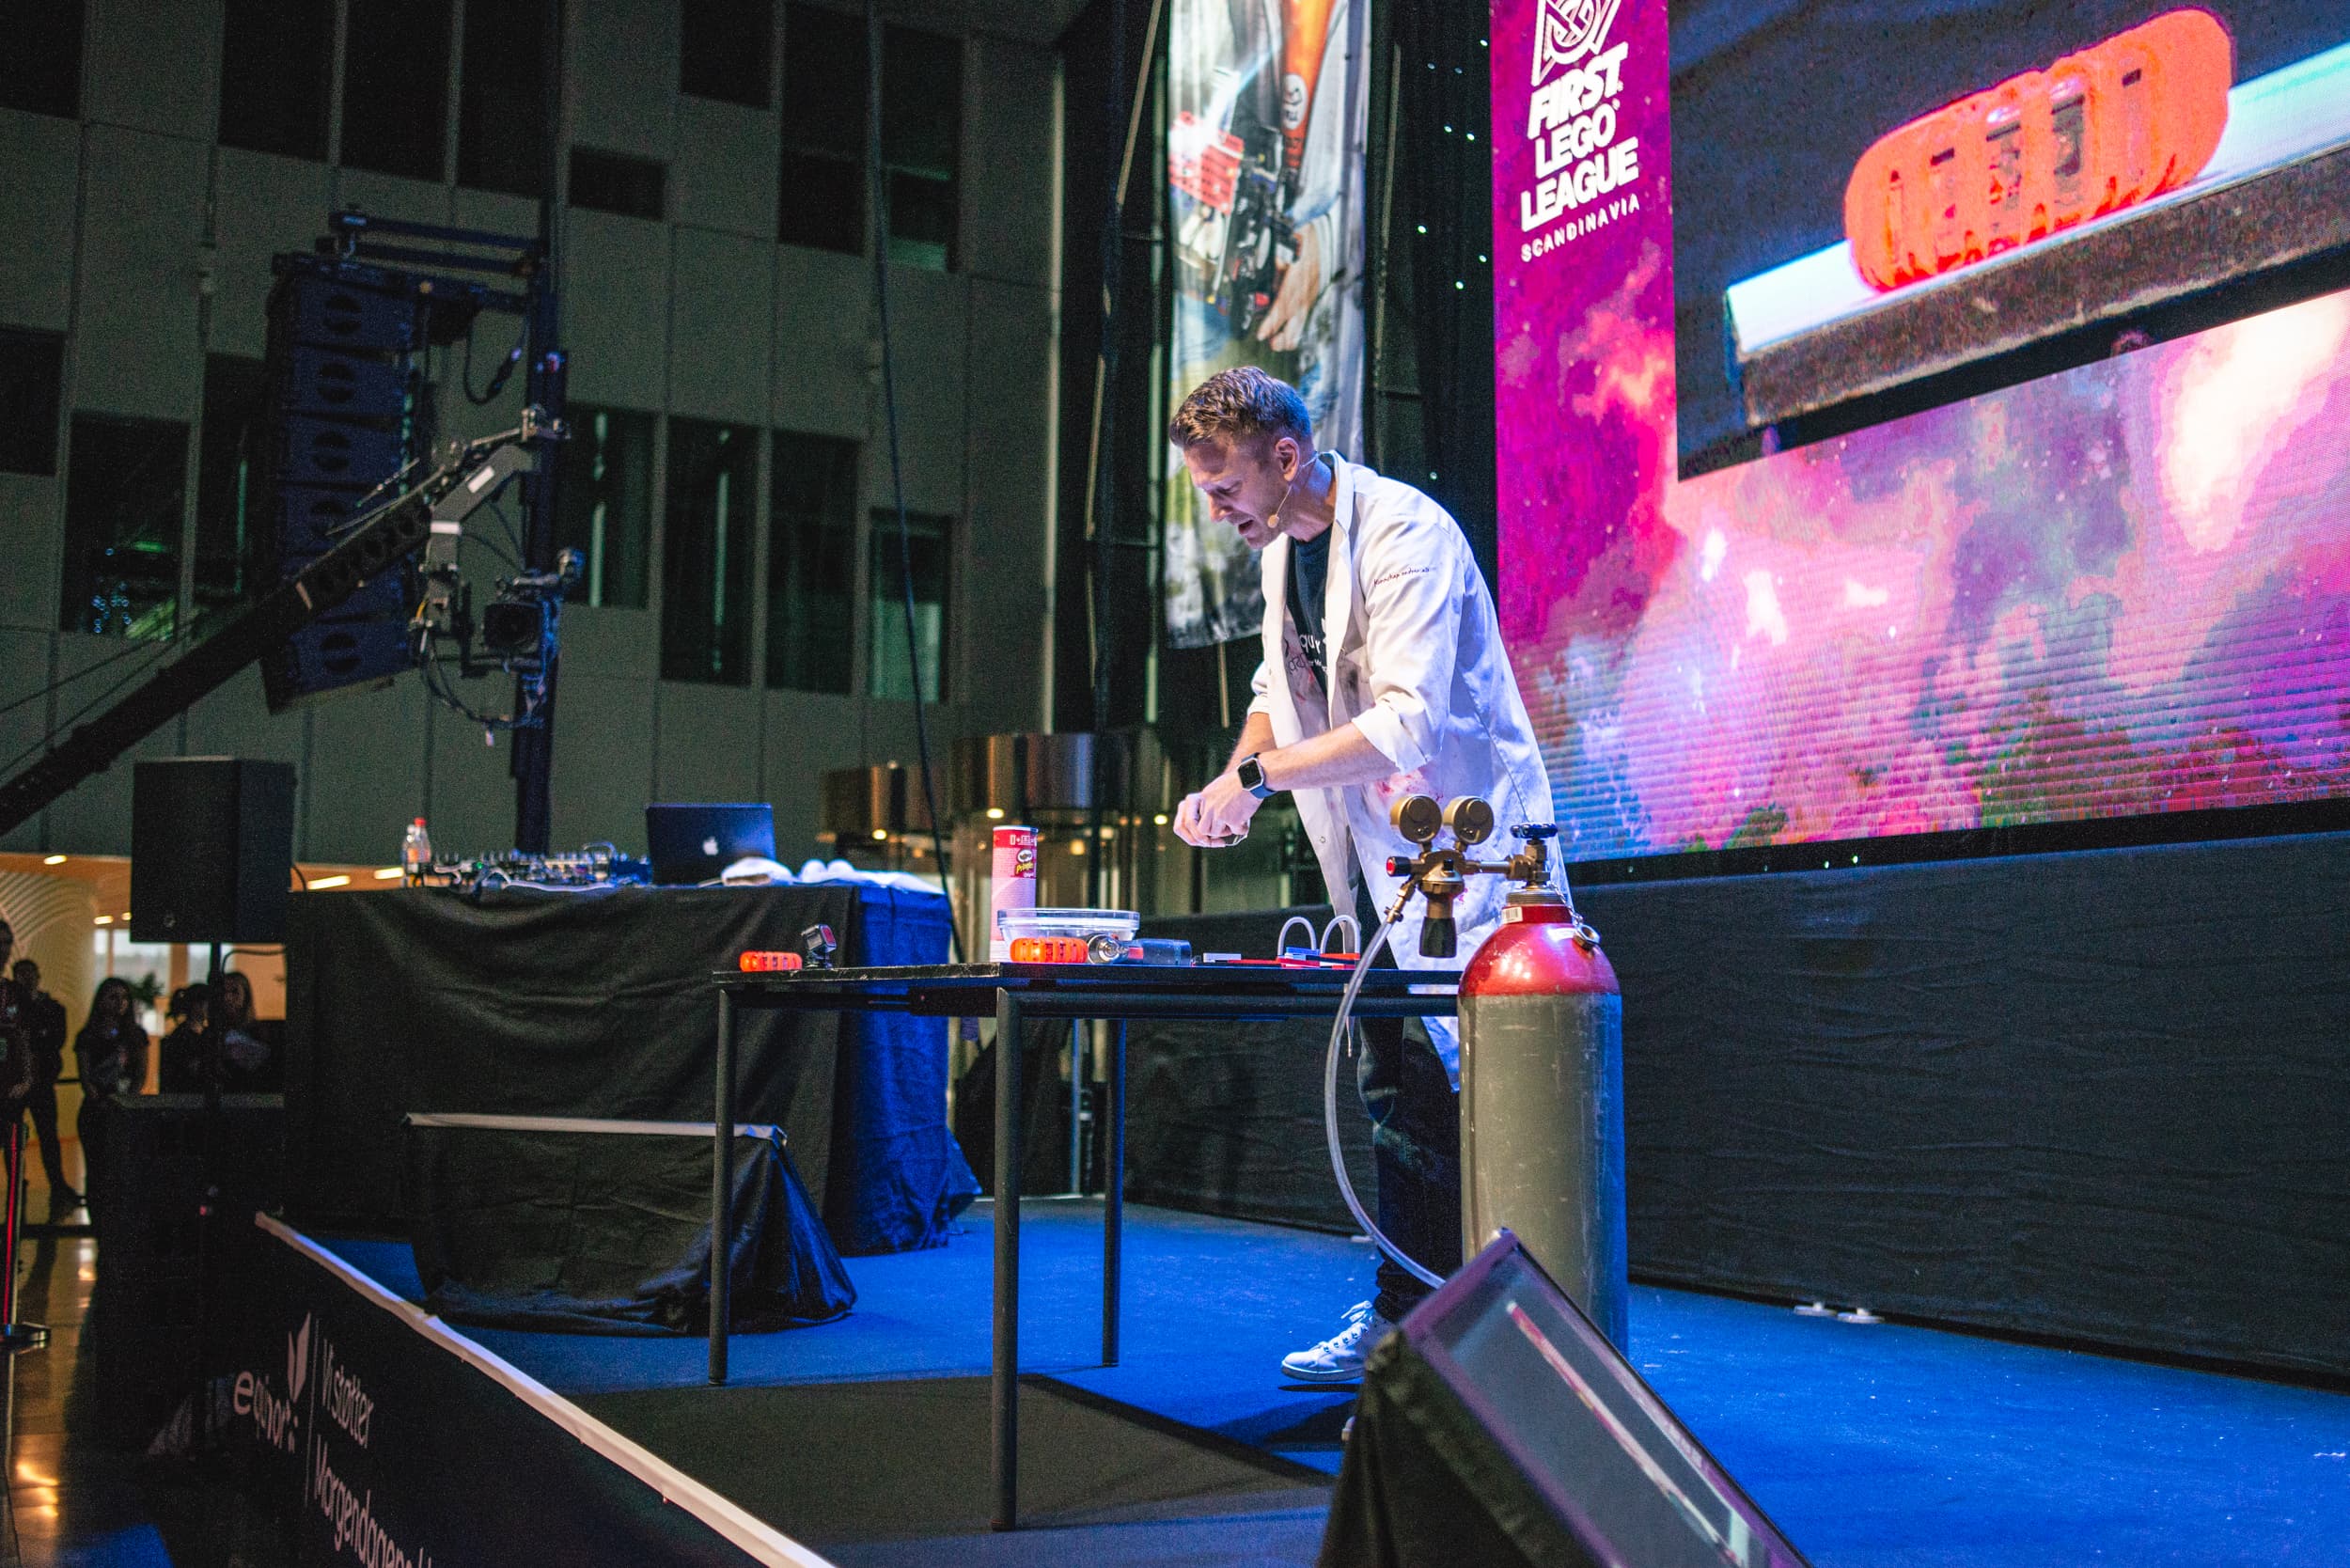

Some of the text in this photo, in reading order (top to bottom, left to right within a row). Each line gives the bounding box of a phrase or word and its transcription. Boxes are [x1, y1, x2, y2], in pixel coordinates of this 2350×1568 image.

[1528, 41, 1629, 140] FIRST
[1535, 102, 1617, 179] LEGO
[1521, 136, 1639, 232] LEAGUE
[1521, 193, 1640, 262] SCANDINAVIA
